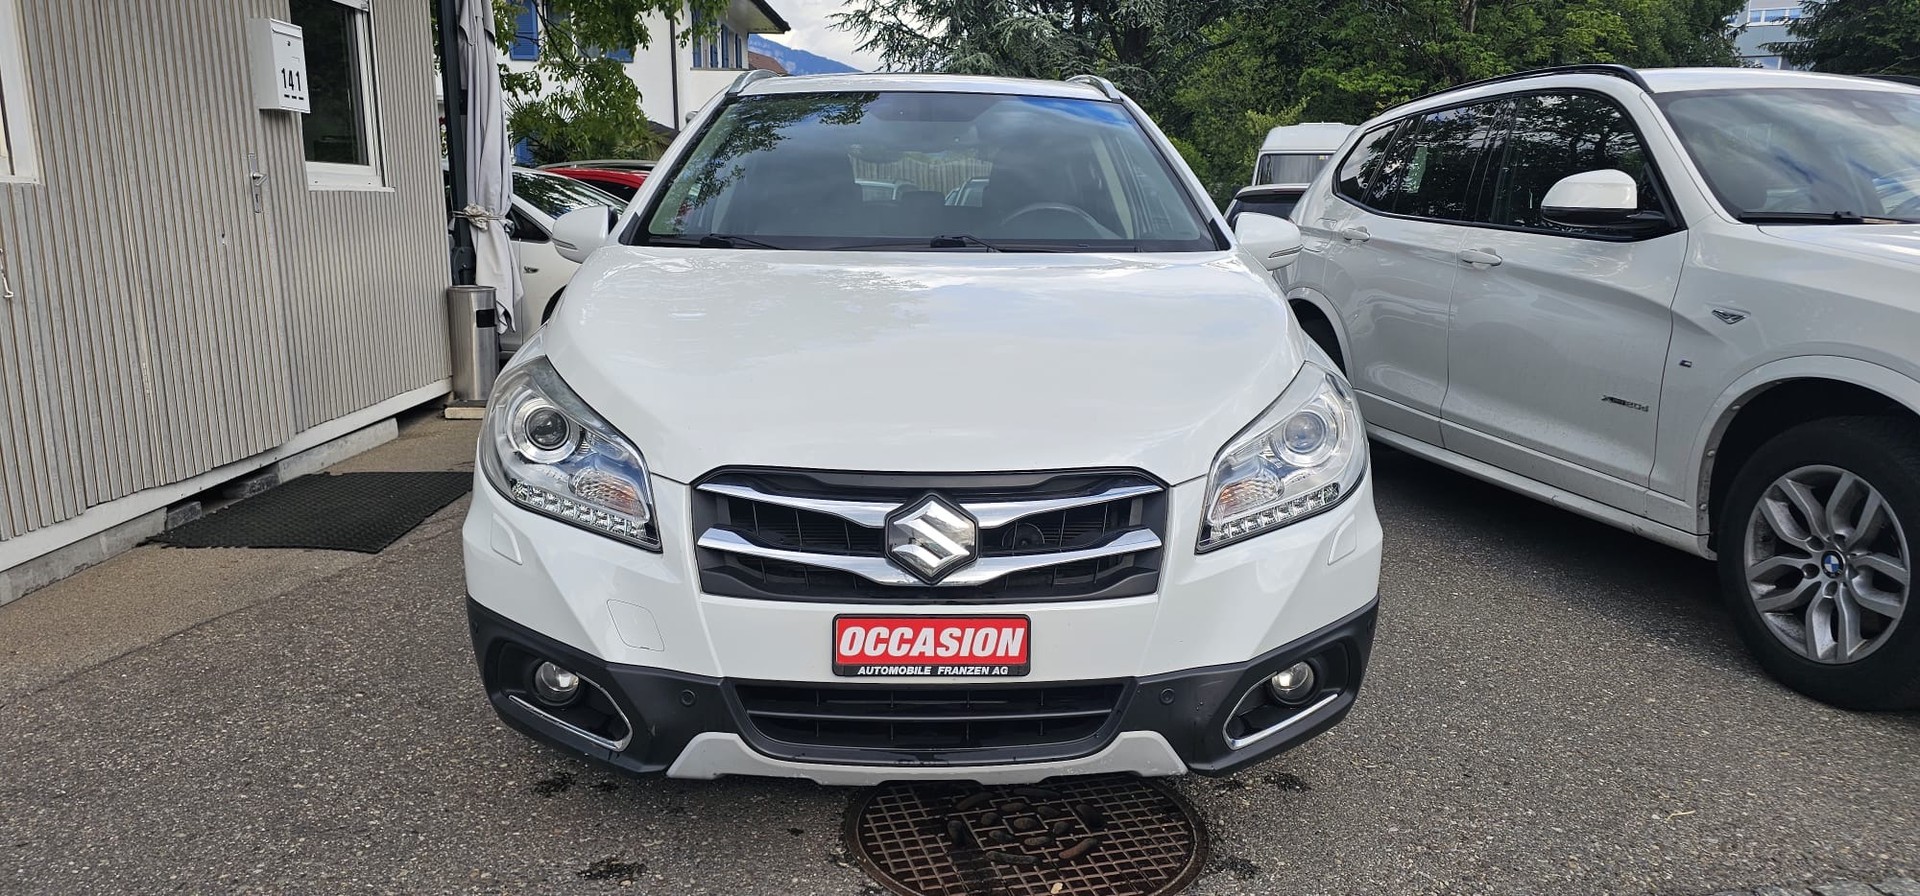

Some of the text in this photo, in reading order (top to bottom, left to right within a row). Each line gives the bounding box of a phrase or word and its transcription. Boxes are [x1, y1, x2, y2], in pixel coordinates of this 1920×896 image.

[281, 67, 302, 92] 141
[839, 626, 1025, 657] OCCASION
[857, 666, 1009, 675] AUTOMOBILE FRANZEN AG
